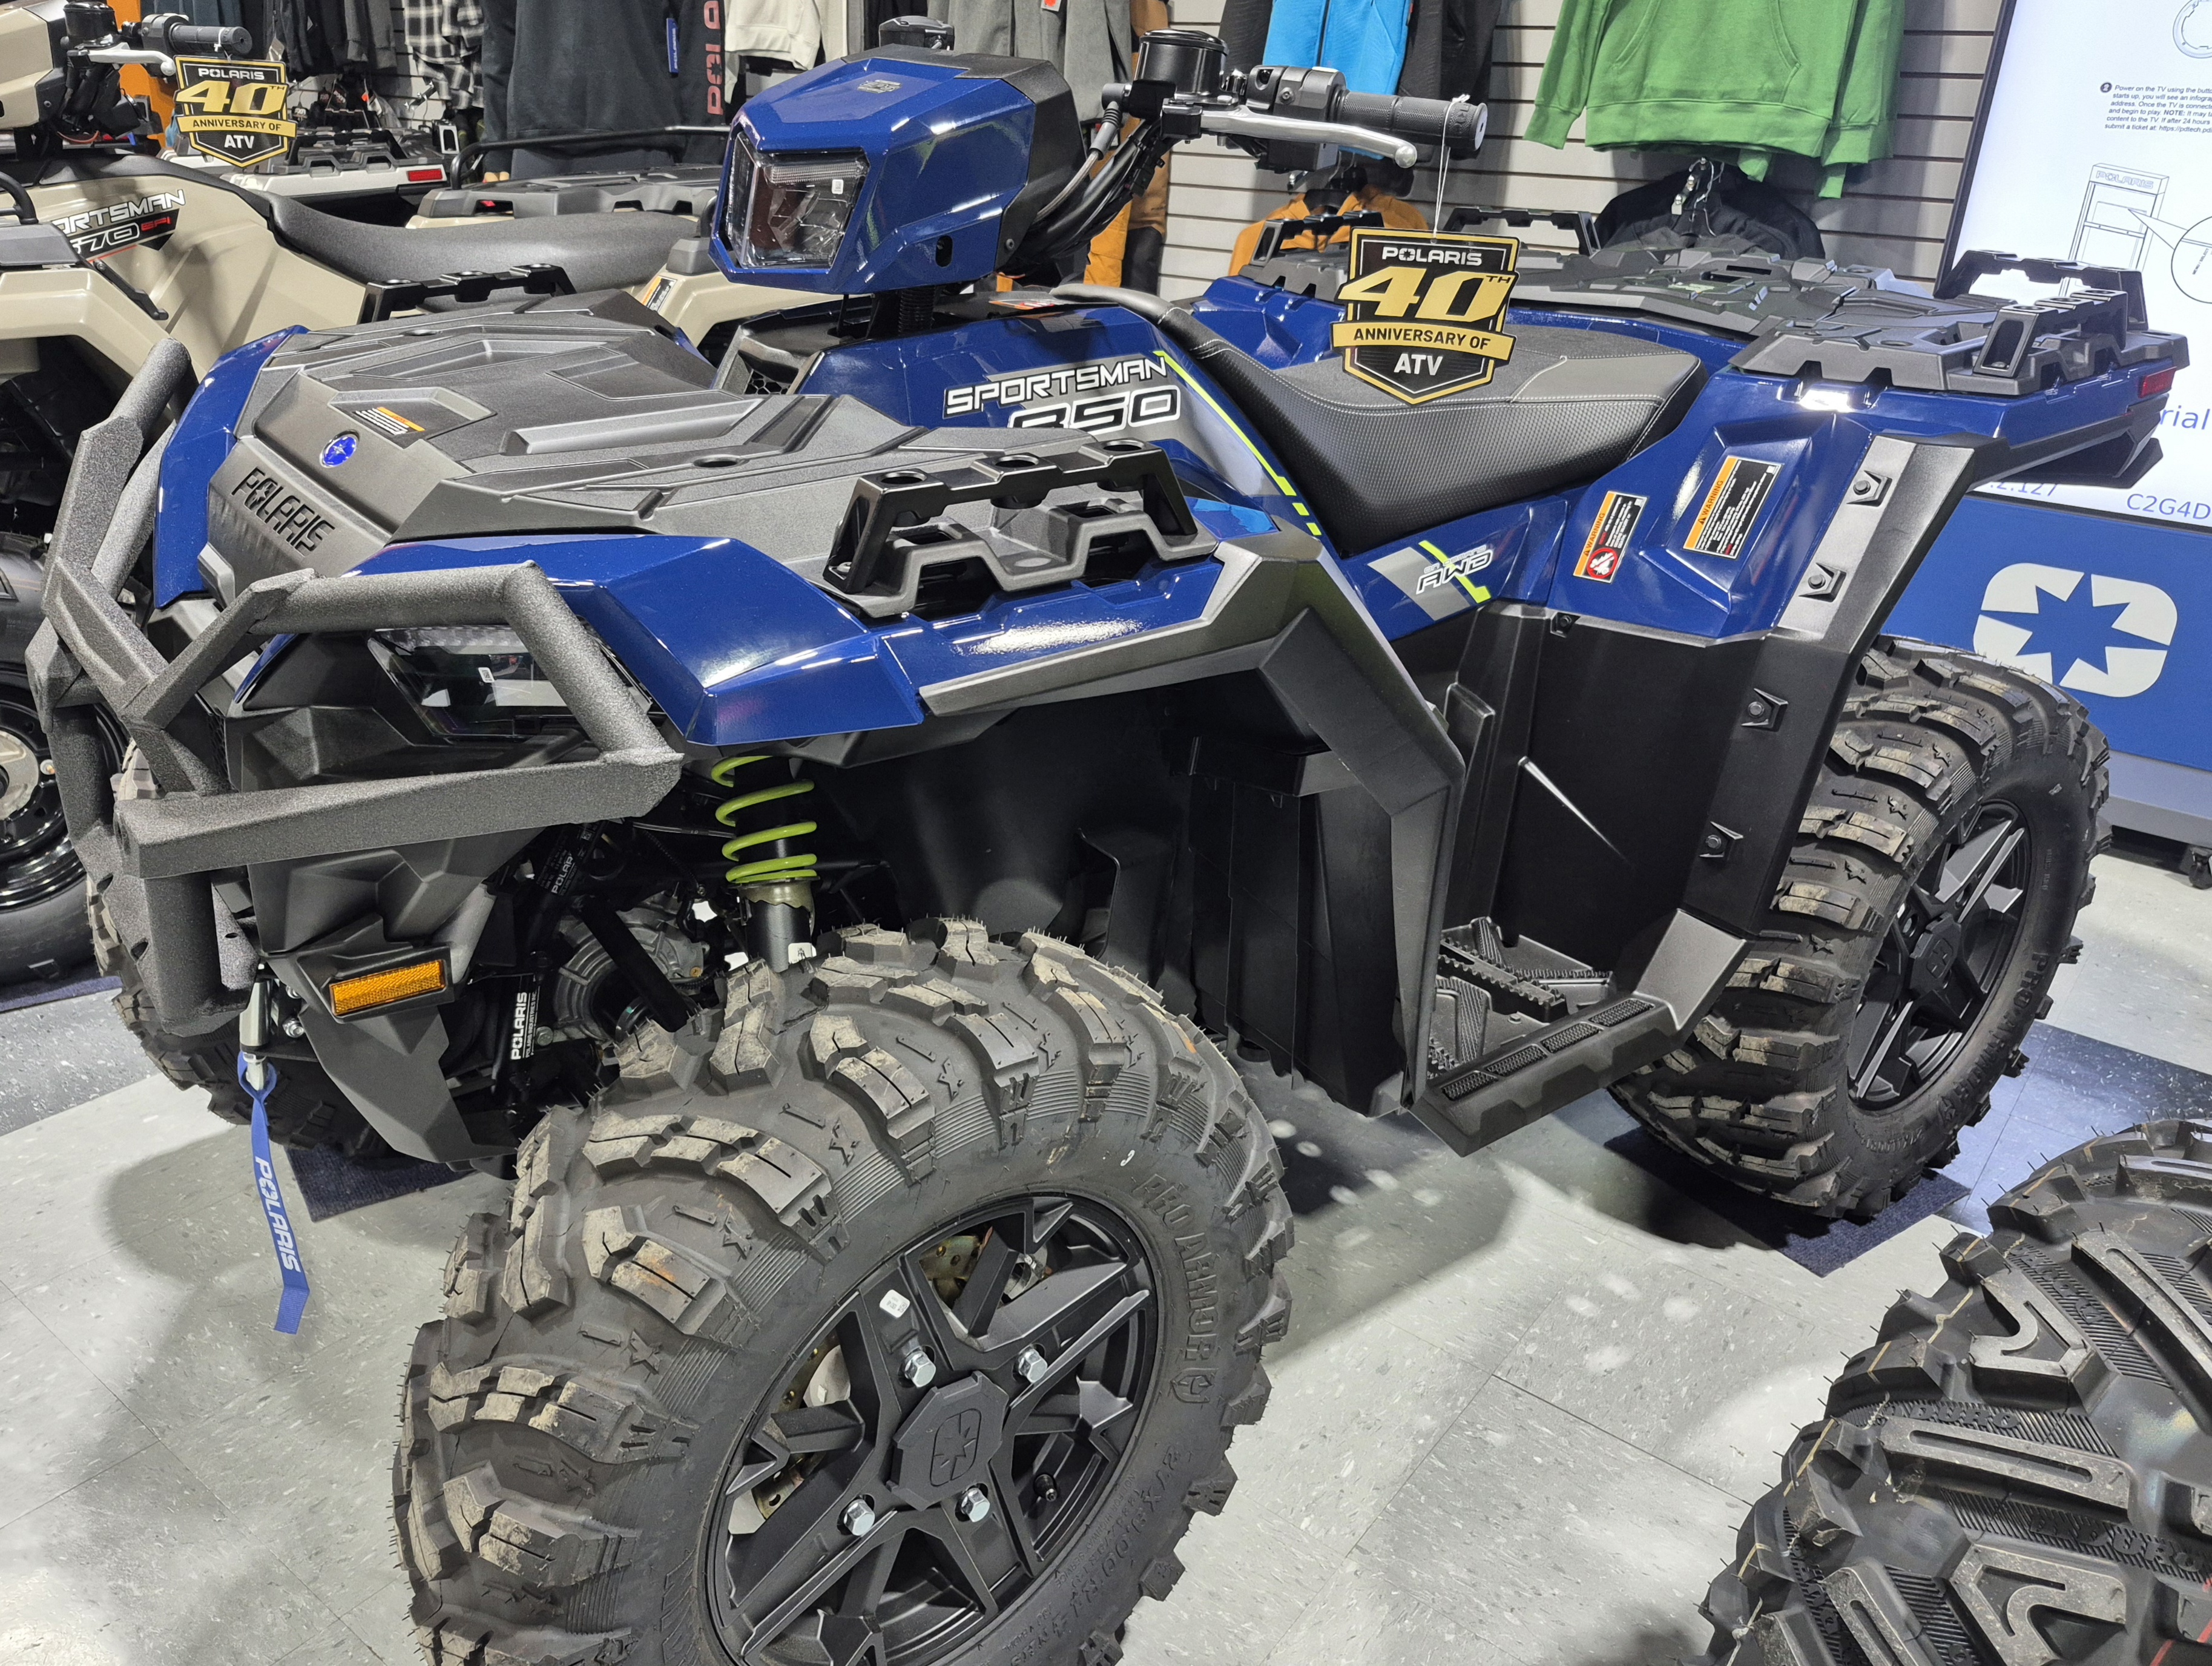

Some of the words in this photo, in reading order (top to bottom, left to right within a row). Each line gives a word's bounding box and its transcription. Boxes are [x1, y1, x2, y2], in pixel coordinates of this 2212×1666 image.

[197, 67, 265, 81] POLARIS
[193, 119, 266, 129] ANNIVERSARY
[268, 123, 282, 131] OF
[224, 134, 255, 148] ATV
[2096, 171, 2154, 189] POLARIS
[1381, 246, 1483, 266] POLARIS
[1353, 328, 1467, 346] ANNIVERSARY
[1469, 335, 1491, 350] OF
[1393, 352, 1444, 376] ATV
[945, 356, 1167, 416] SPORTSMAN
[231, 467, 336, 558] POLARIS
[1702, 480, 1723, 516] WARNING
[1586, 512, 1605, 550] WARNING
[1415, 549, 1493, 595] AWD
[2013, 951, 2051, 1009] PRO
[510, 992, 528, 1060] POLARIS
[527, 1001, 536, 1035] INDUSTRIES
[255, 1156, 301, 1273] POLARIS
[1131, 1173, 1192, 1231] PRO
[1174, 1232, 1219, 1361] ARMOR
[1053, 1549, 1087, 1589] SERVICE
